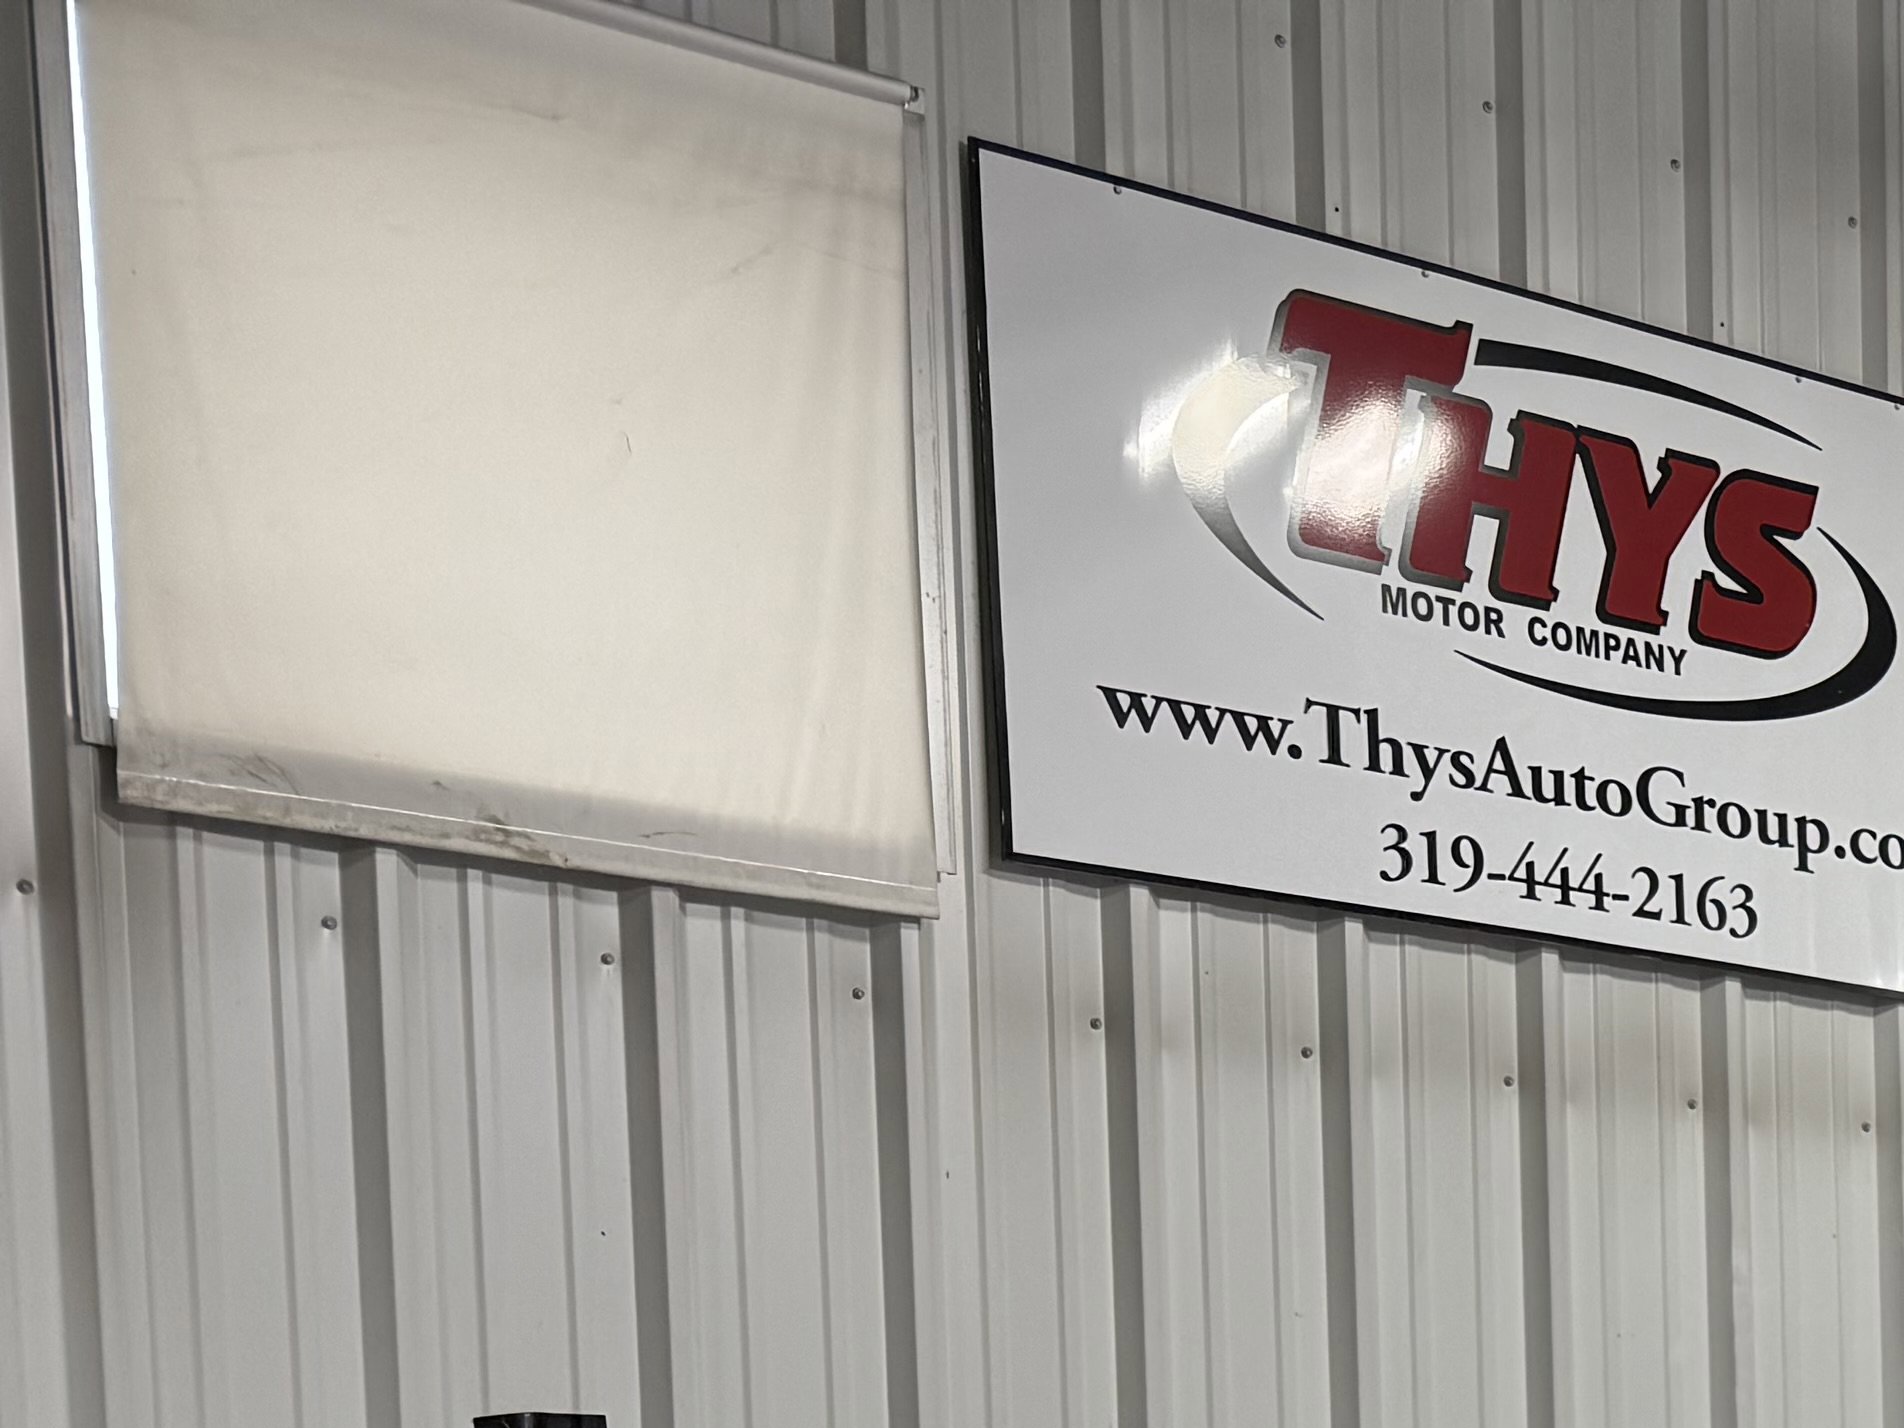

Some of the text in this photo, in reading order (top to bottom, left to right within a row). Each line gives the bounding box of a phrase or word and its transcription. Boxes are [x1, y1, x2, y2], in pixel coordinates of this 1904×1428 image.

[1267, 288, 1821, 660] THYS
[1380, 582, 1689, 677] MOTOR COMPANY
[1377, 821, 1760, 940] 319-444-2163
